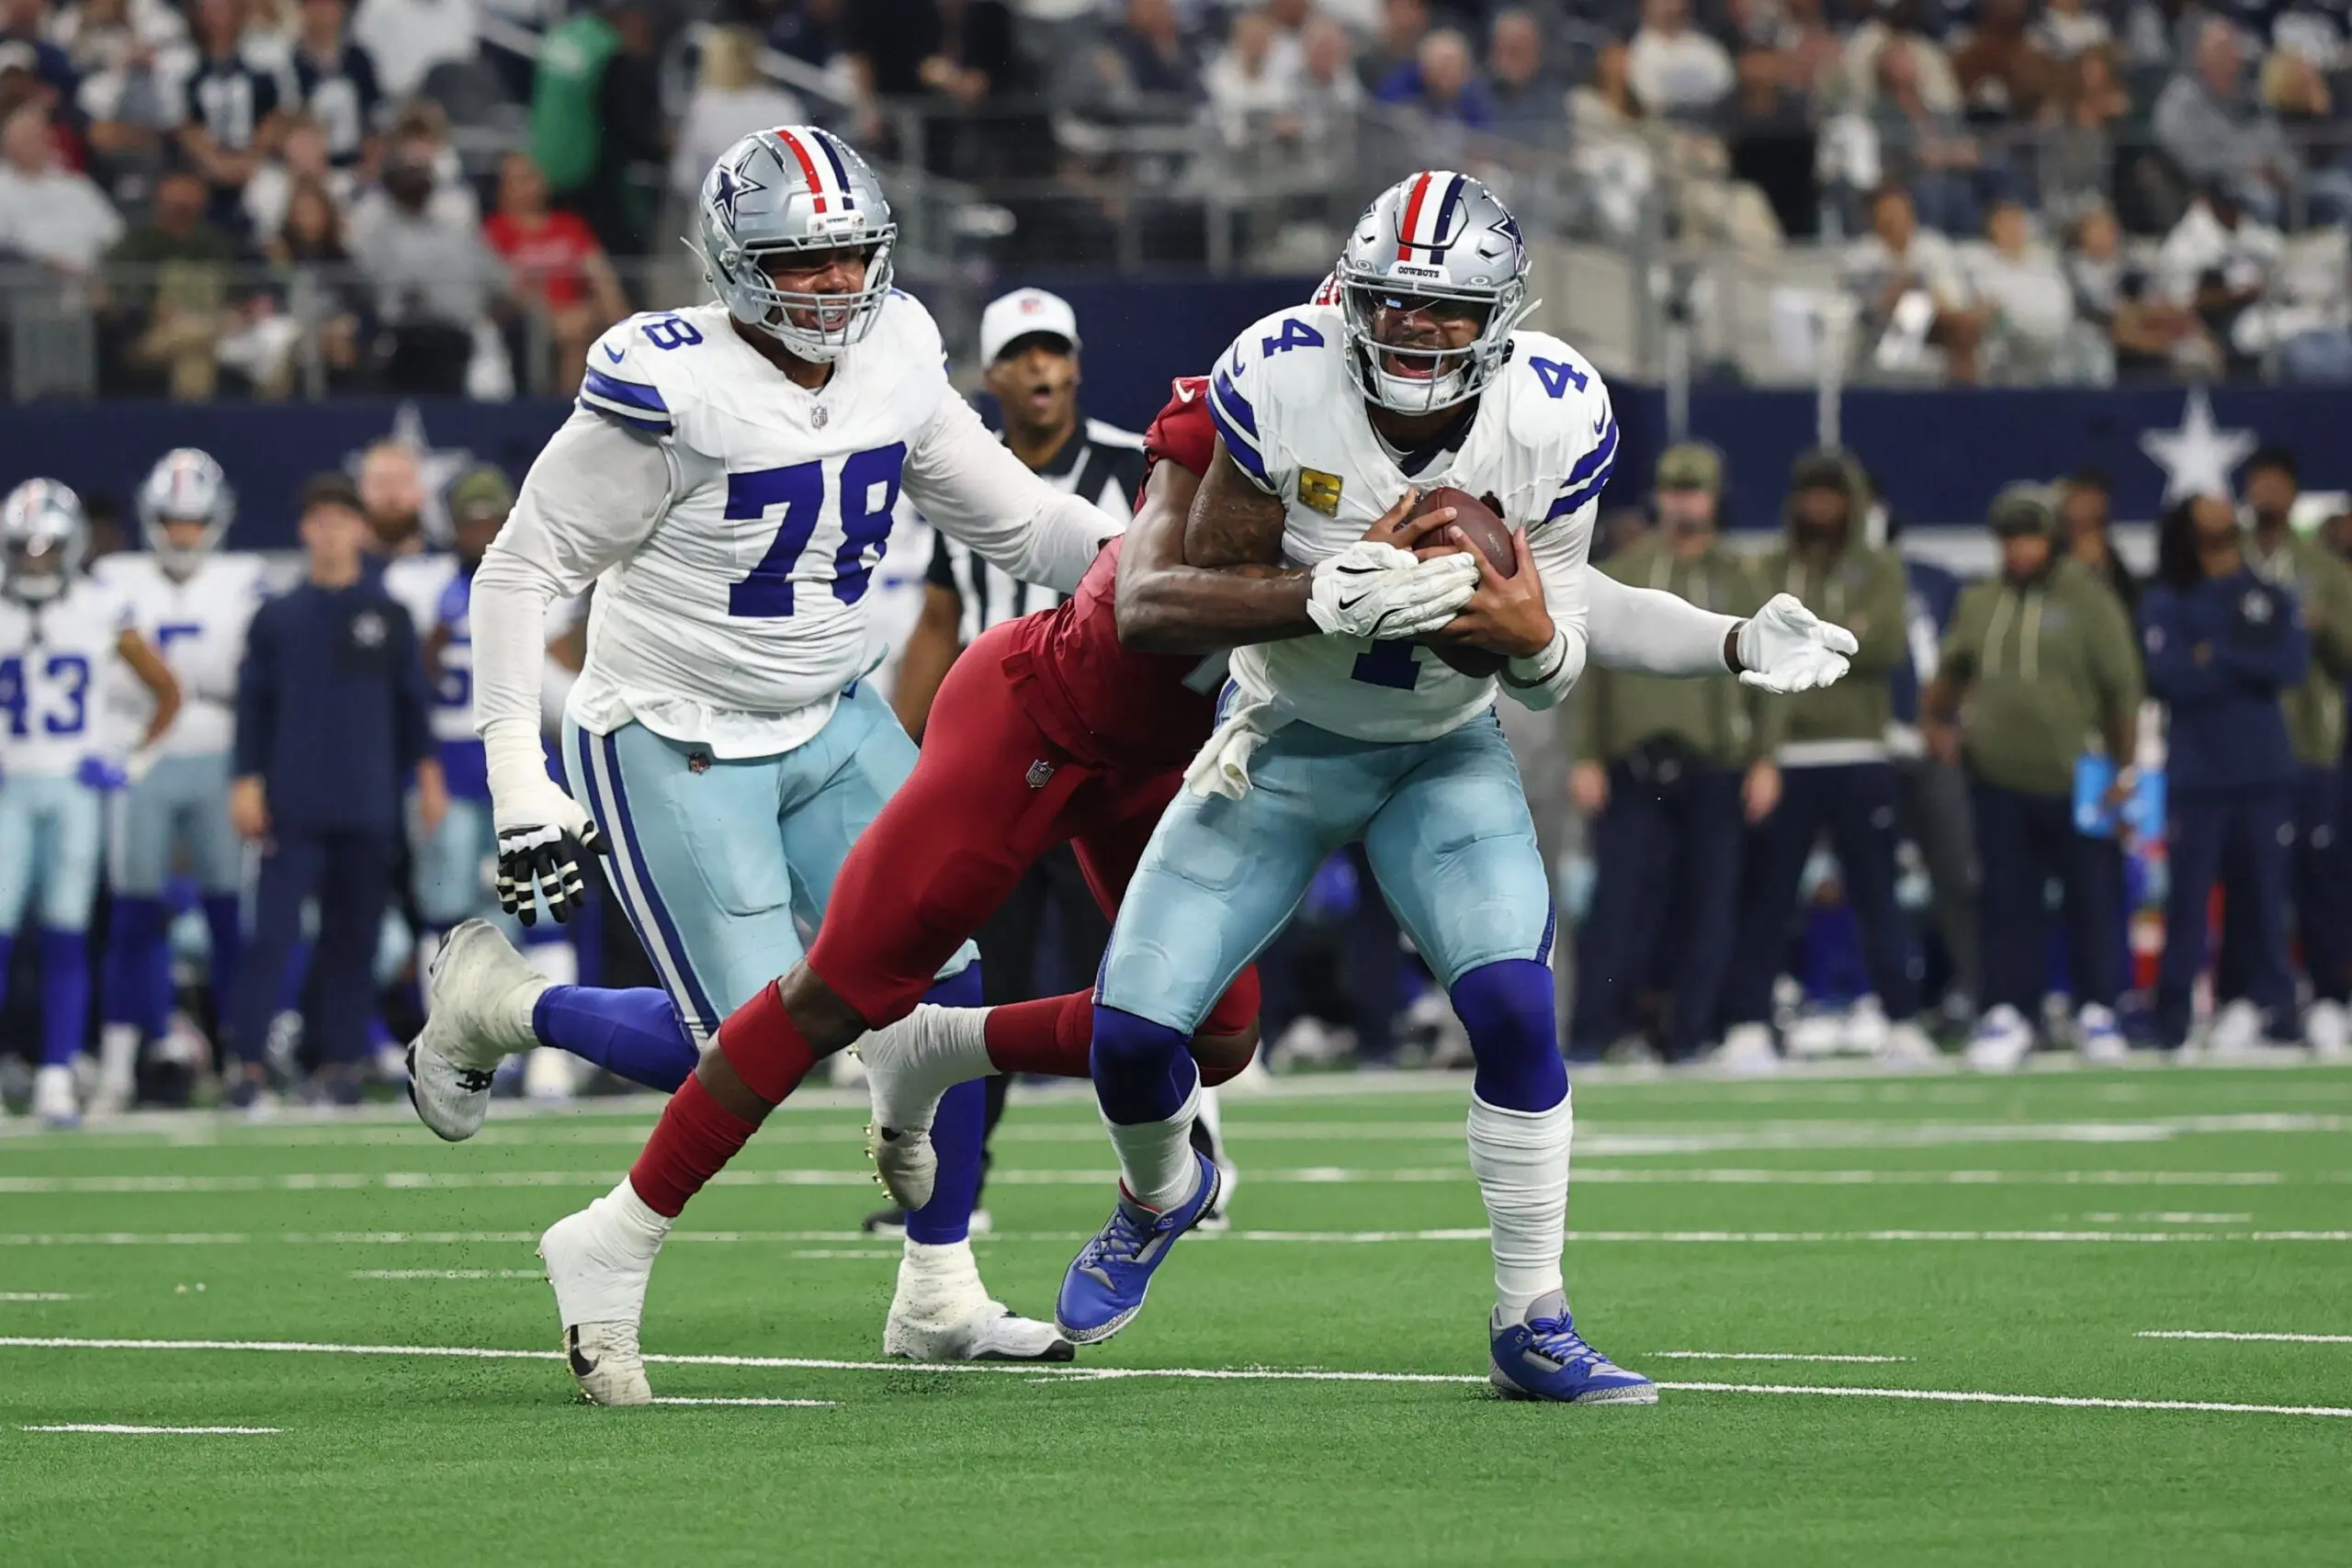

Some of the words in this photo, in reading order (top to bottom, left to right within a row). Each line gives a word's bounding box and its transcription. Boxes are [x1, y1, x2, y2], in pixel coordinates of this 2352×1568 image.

[1397, 265, 1441, 278] COWBOYS
[1261, 318, 1325, 359] 4
[1528, 355, 1589, 398] 4
[723, 441, 907, 617] 78
[0, 657, 89, 736] 43
